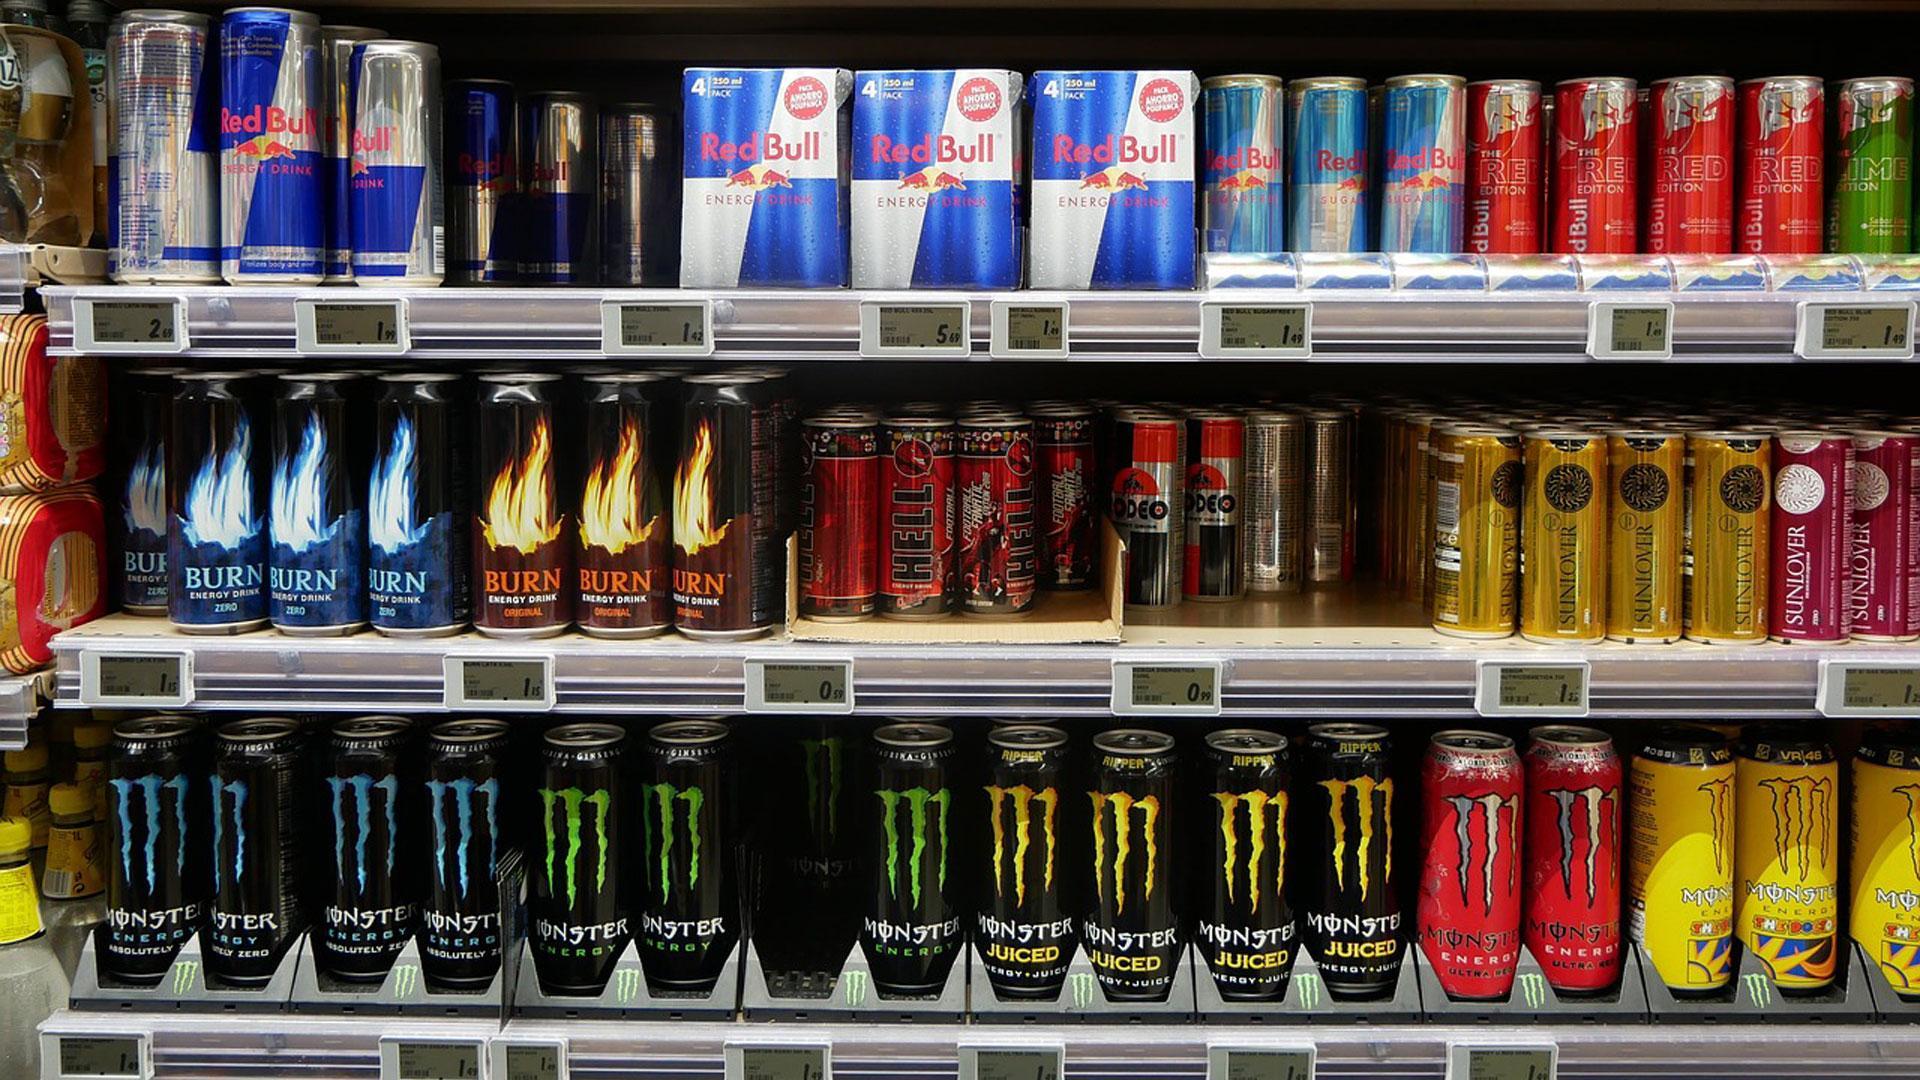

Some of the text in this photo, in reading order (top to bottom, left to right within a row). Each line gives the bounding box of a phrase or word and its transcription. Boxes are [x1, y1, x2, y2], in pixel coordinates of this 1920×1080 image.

[691, 77, 742, 96] 4 250 ml
[711, 90, 732, 98] PACK
[861, 79, 914, 98] 4 250 ml
[1044, 79, 1096, 98] 4 250 ml
[221, 105, 317, 135] Red Bull
[701, 131, 820, 162] Red Bull
[871, 133, 994, 163] Red Bull
[1053, 133, 1177, 163] Red Bull
[1481, 150, 1501, 158] THE
[1578, 148, 1600, 157] THE
[1658, 147, 1676, 155] THE
[1754, 147, 1775, 156] THE
[1247, 147, 1281, 170] Bull
[1317, 149, 1361, 171] Red
[1431, 147, 1465, 170] Bull
[271, 164, 313, 176] DRINK
[1657, 155, 1728, 183] RED
[1752, 156, 1822, 183] RED
[1480, 185, 1526, 195] EDITION
[1577, 184, 1624, 194] EDITION
[1657, 183, 1703, 193] EDITION
[1753, 183, 1803, 194] EDITION
[706, 195, 813, 206] ENERGY DRINK
[877, 197, 987, 208] ENERGY DRINK
[1059, 197, 1168, 208] ENERGY DRINK
[1473, 200, 1490, 236] Bull
[1569, 199, 1588, 237] Bull
[1651, 198, 1665, 236] Bull
[1746, 199, 1763, 237] Bull
[891, 483, 934, 582] HELL
[1005, 480, 1035, 581] HELL
[185, 563, 264, 589] BURN
[270, 567, 337, 591] BURN
[485, 568, 561, 593] BURN
[1500, 521, 1515, 624] SUNLOVER
[1559, 524, 1578, 625] SUNLOVER
[1634, 524, 1653, 624] SUNLOVER
[1735, 525, 1752, 625] SUNLOVER
[1786, 524, 1805, 625] SUNLOVER
[1851, 521, 1870, 621] SUNLOVER
[579, 569, 652, 593] BURN
[673, 570, 726, 595] URN
[190, 588, 260, 599] ENERGY DRINK
[301, 594, 332, 602] DRINK
[391, 595, 421, 604] DRINK
[489, 593, 557, 604] ENERGY DRINK
[582, 593, 647, 604] ENERGY DRINK
[691, 597, 720, 606] DRINK
[214, 603, 238, 613] ZERO
[286, 605, 306, 616] ZERO
[379, 606, 396, 617] ZERO
[504, 607, 544, 618] ORIGINAL
[594, 607, 632, 617] ORIGINAL
[1001, 750, 1044, 762] RIPPER
[1339, 742, 1381, 752] RIPPER
[1102, 756, 1145, 769] RIPPER
[1232, 754, 1275, 767] RIPPER
[1746, 880, 1837, 905] MONSTE
[328, 929, 407, 941] ENERGY
[643, 911, 726, 944] ONSTER
[865, 916, 960, 943] MONSTER
[978, 911, 1073, 943] MONSTER
[1200, 920, 1296, 949] MONSTER
[429, 933, 496, 946] ENERG
[1324, 939, 1396, 958] JUICED
[238, 948, 270, 958] ZERO
[875, 943, 953, 957] ENERGY
[986, 943, 1060, 963] JUICED
[1215, 950, 1289, 969] JUICED
[1090, 949, 1161, 972] JUICED
[1552, 959, 1594, 970] ULTRA
[1132, 975, 1170, 987] JUICE
[1449, 967, 1490, 978] ULTRA
